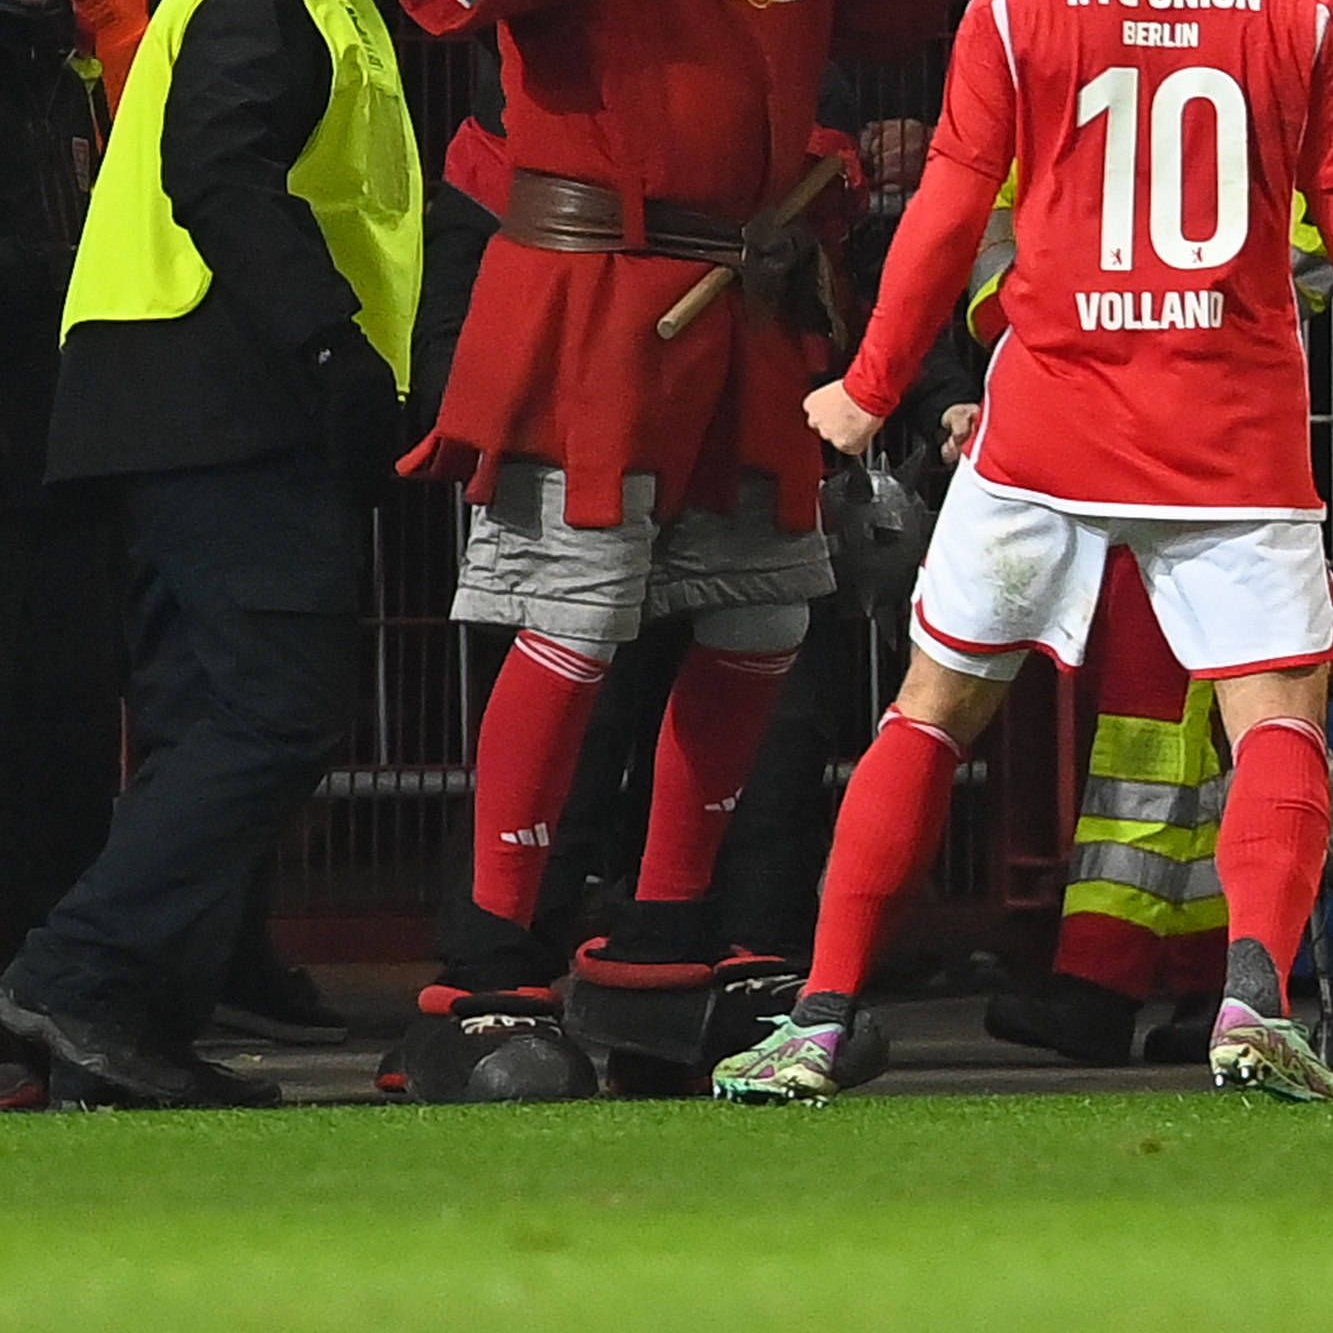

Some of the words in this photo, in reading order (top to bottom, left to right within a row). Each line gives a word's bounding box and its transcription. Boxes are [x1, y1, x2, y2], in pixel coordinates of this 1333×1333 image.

[1122, 20, 1199, 48] BERLIN
[1076, 67, 1248, 271] 10
[1075, 291, 1224, 331] VOLLAND
